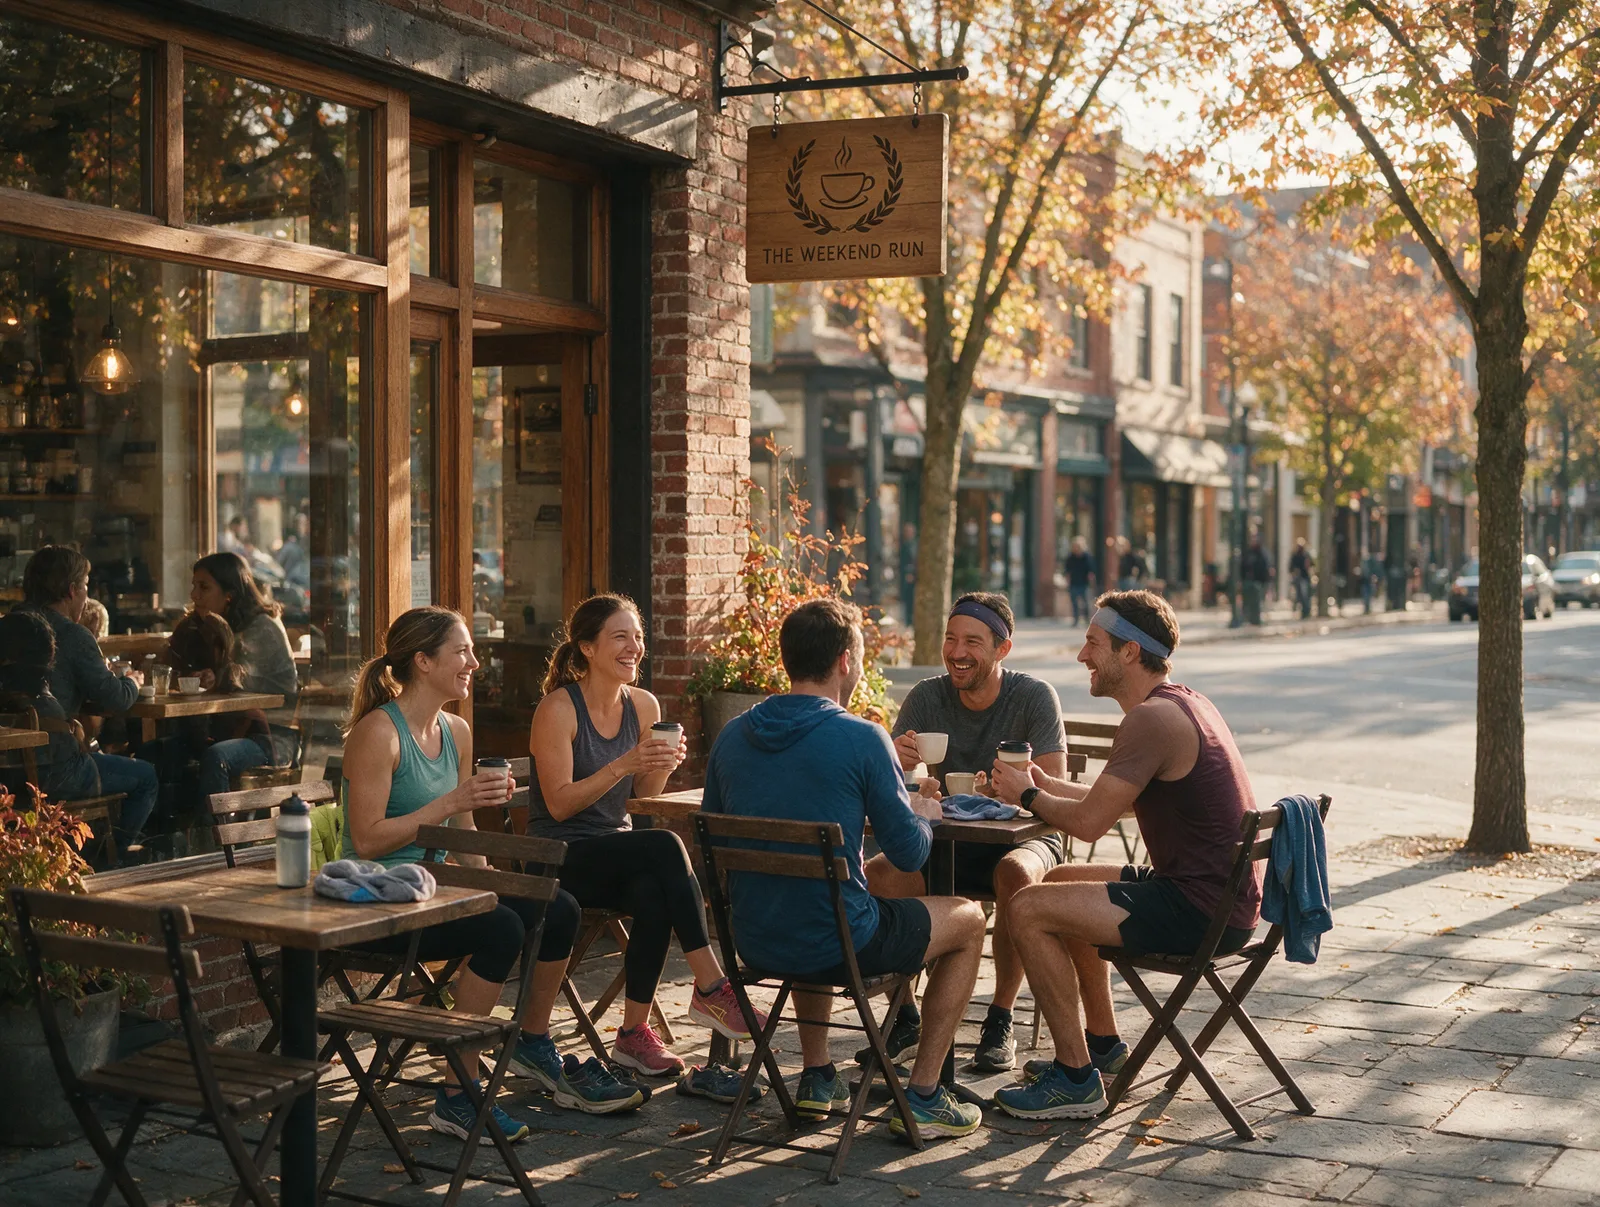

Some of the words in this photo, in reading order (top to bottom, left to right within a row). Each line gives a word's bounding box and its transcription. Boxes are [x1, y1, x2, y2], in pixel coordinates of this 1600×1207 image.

[763, 248, 794, 264] THE
[800, 243, 881, 262] WEEKEND
[889, 241, 924, 258] RUN
